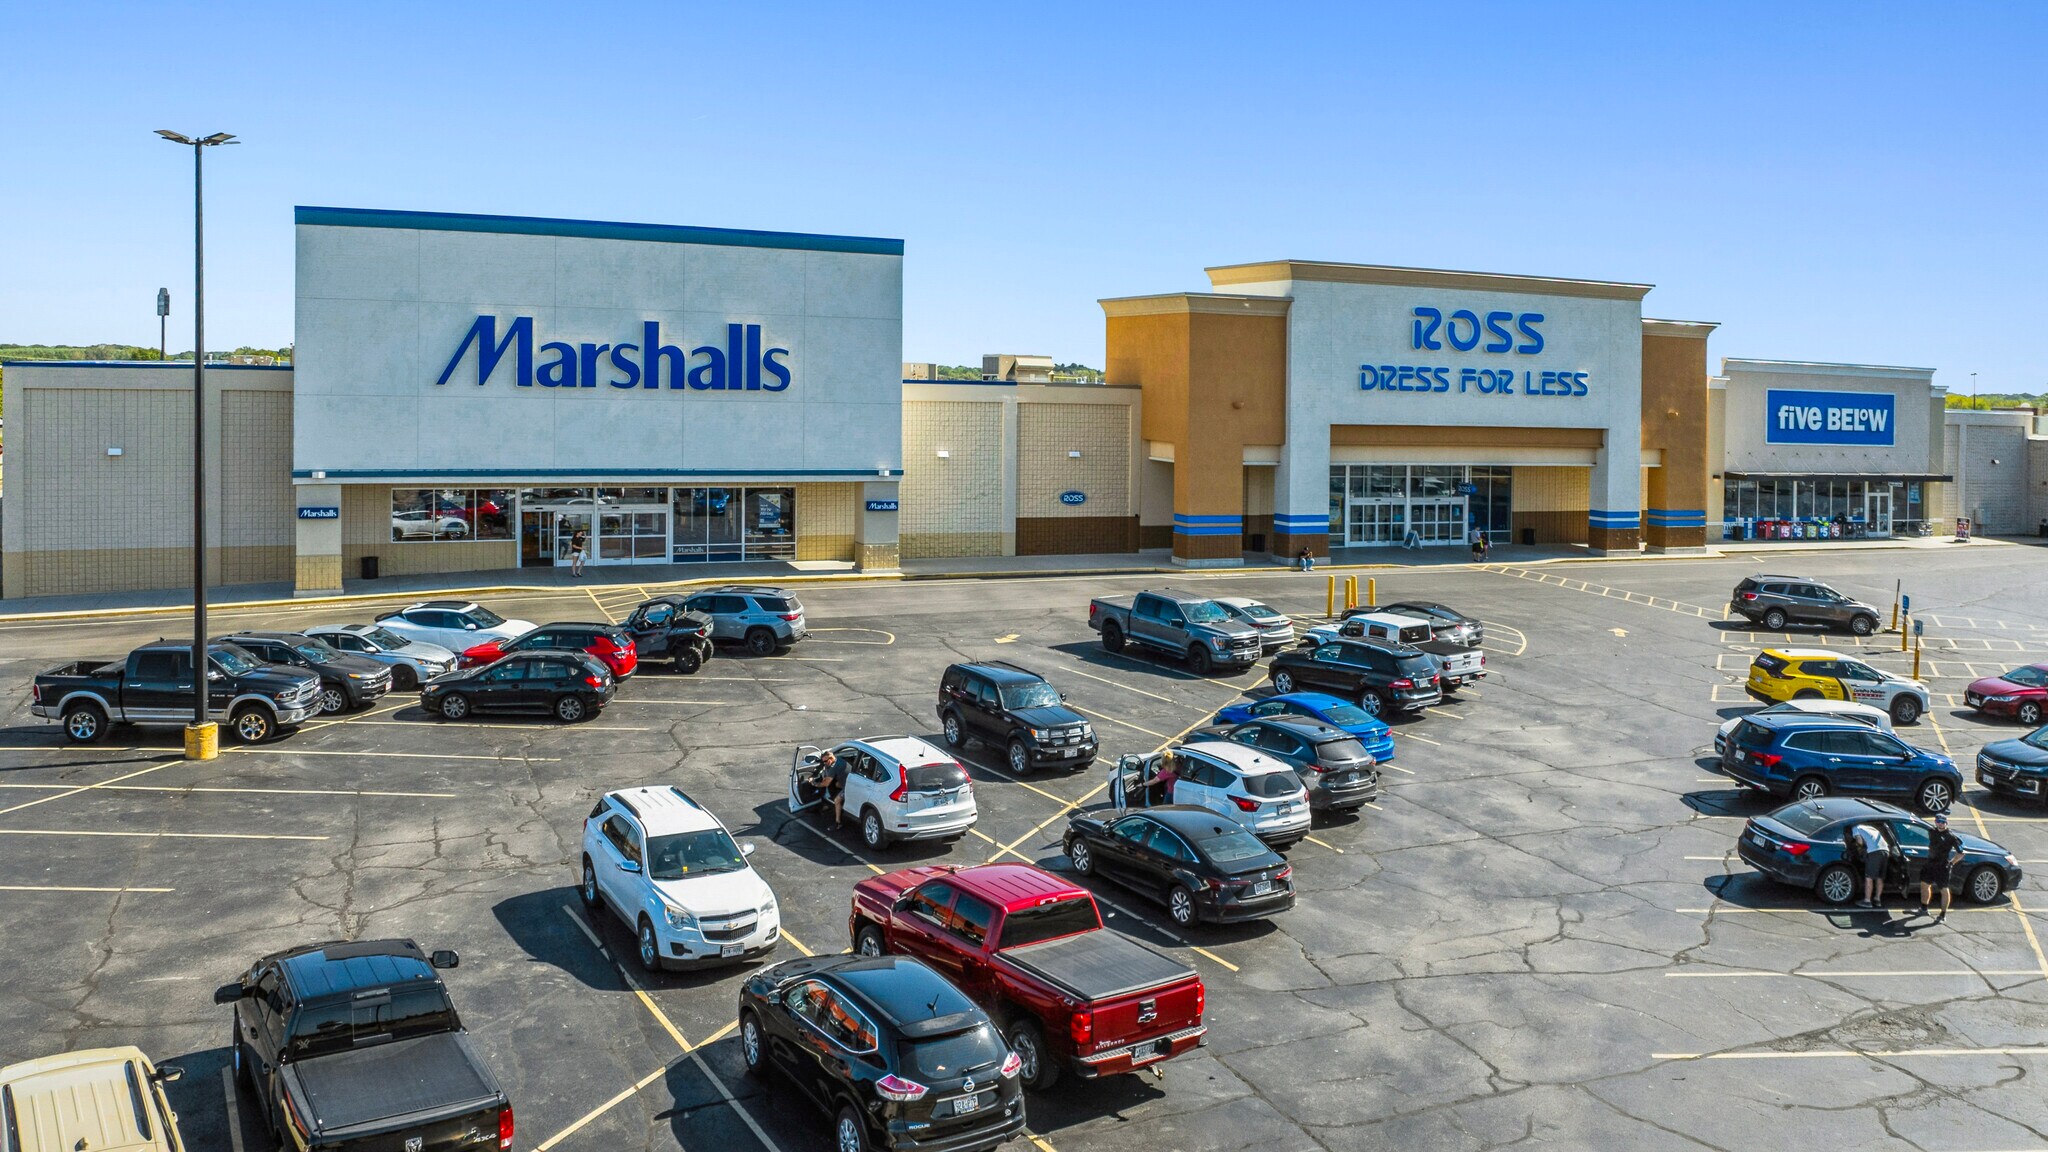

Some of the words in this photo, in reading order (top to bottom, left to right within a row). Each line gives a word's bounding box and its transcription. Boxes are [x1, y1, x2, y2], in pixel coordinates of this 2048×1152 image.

[1411, 307, 1545, 355] ROSS
[436, 315, 791, 391] Marshalls
[1359, 364, 1450, 393] DRESS
[1459, 367, 1515, 395] FOR
[1526, 370, 1589, 397] LESS
[1778, 405, 1822, 430] five
[1063, 494, 1084, 502] ROSS
[300, 509, 338, 517] Marshalls
[908, 1123, 931, 1131] ROGUE
